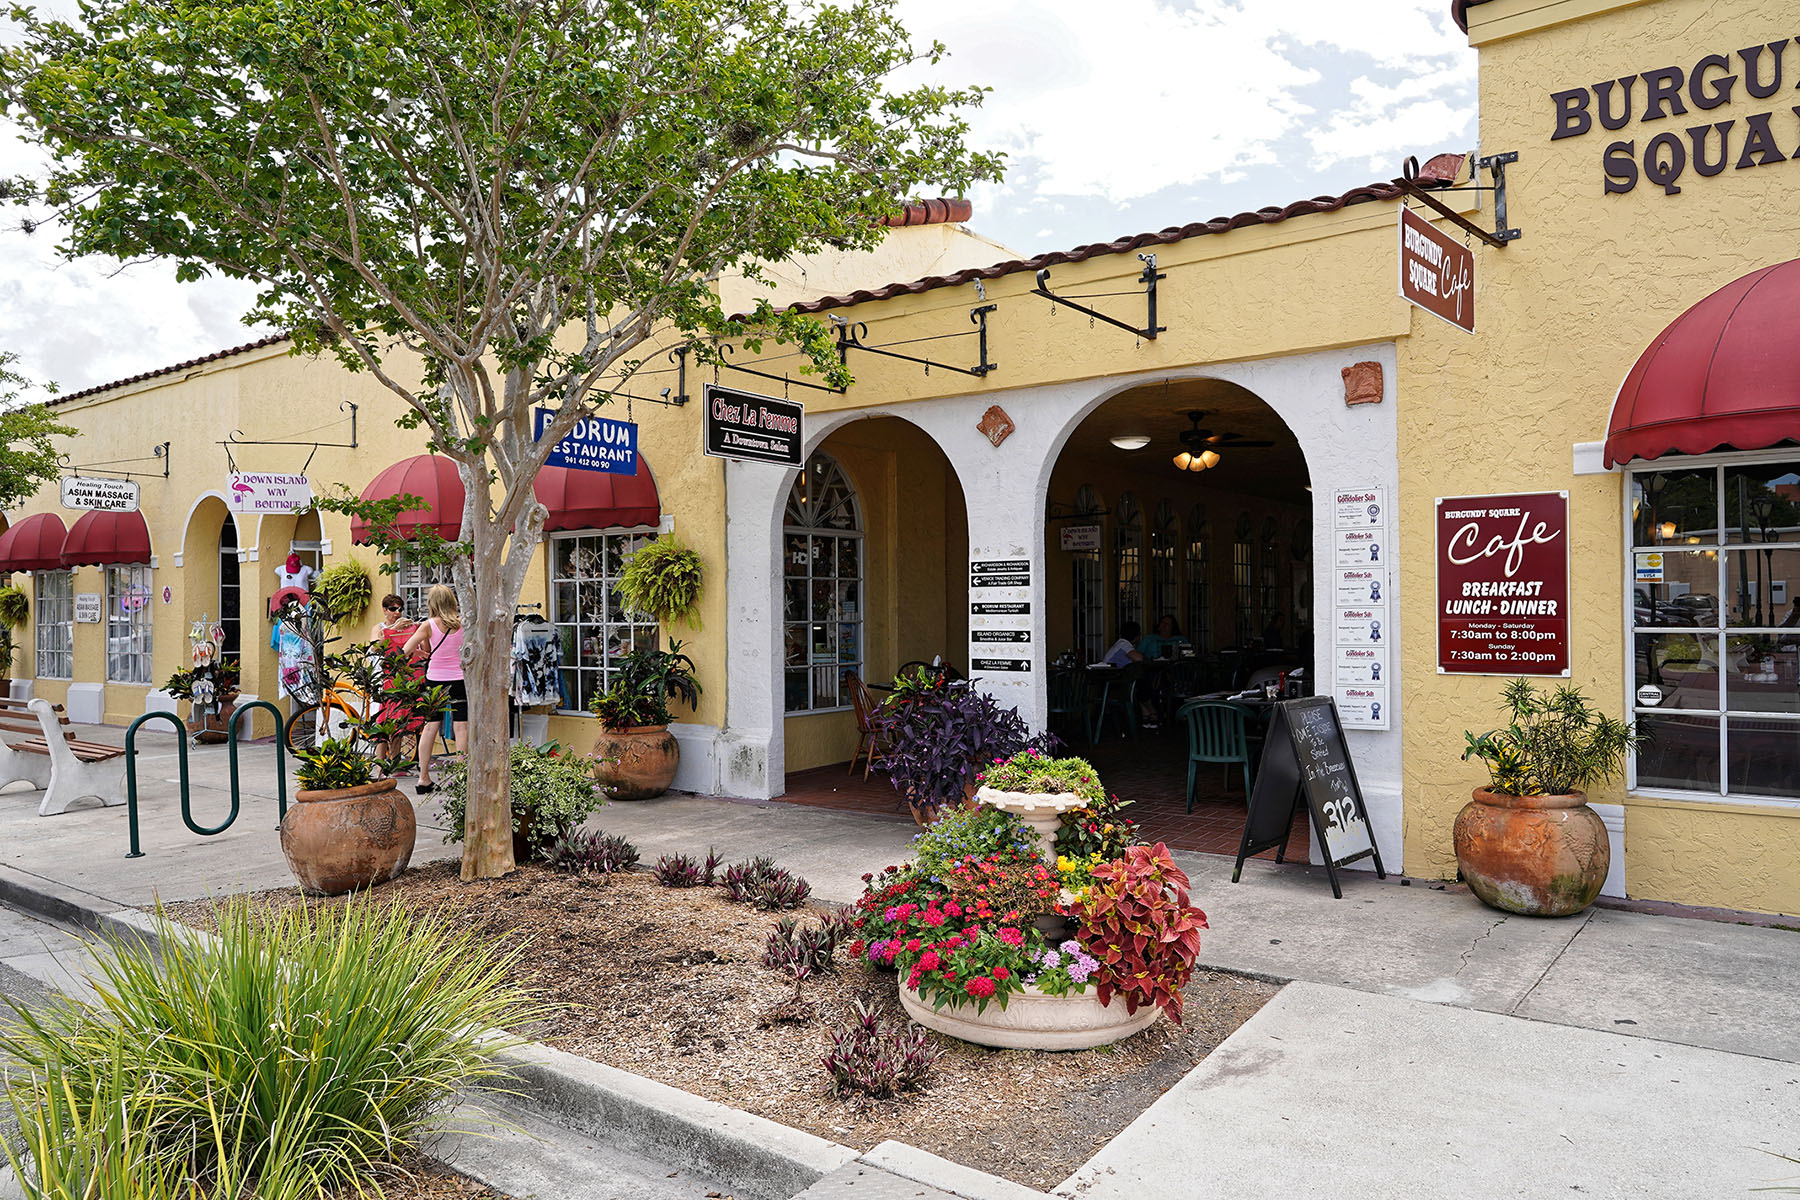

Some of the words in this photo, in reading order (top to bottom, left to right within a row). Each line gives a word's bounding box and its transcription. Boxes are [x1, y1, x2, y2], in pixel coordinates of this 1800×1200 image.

[1550, 36, 1800, 141] BURGU
[1604, 105, 1800, 195] SQUA
[1405, 223, 1442, 269] BURGUNDY
[1409, 258, 1437, 296] SQUARE
[1441, 255, 1471, 320] Cafe
[712, 397, 740, 423] Chez
[742, 403, 757, 427] La
[759, 406, 797, 434] Femme
[723, 432, 731, 443] A
[732, 433, 769, 449] Downtown
[770, 440, 789, 452] Salon
[552, 441, 632, 463] ESTAURANT
[579, 458, 590, 466] 412
[243, 475, 272, 484] DOWN
[274, 476, 308, 485] ISLAND
[68, 488, 93, 497] ASIAN
[96, 490, 134, 500] MASSAGE
[267, 488, 287, 496] WAY
[1337, 494, 1363, 503] Gondolier
[75, 497, 81, 506] &
[84, 498, 102, 506] SKIN
[105, 500, 126, 508] CARE
[255, 500, 300, 509] BOUTIQUE
[1445, 510, 1487, 519] BURGUNDY
[1489, 508, 1520, 518] SQUARE
[1448, 511, 1560, 578] Cafe
[1462, 581, 1543, 597] BREAKFAST
[1450, 630, 1492, 639] 7:30am
[1495, 631, 1507, 639] to
[1511, 630, 1556, 641] 8:00pm
[1450, 651, 1492, 660] 7:30am
[1495, 652, 1507, 660] to
[1511, 651, 1556, 662] 2:00pm
[1300, 709, 1323, 725] PLEASE
[1323, 796, 1356, 831] 312
